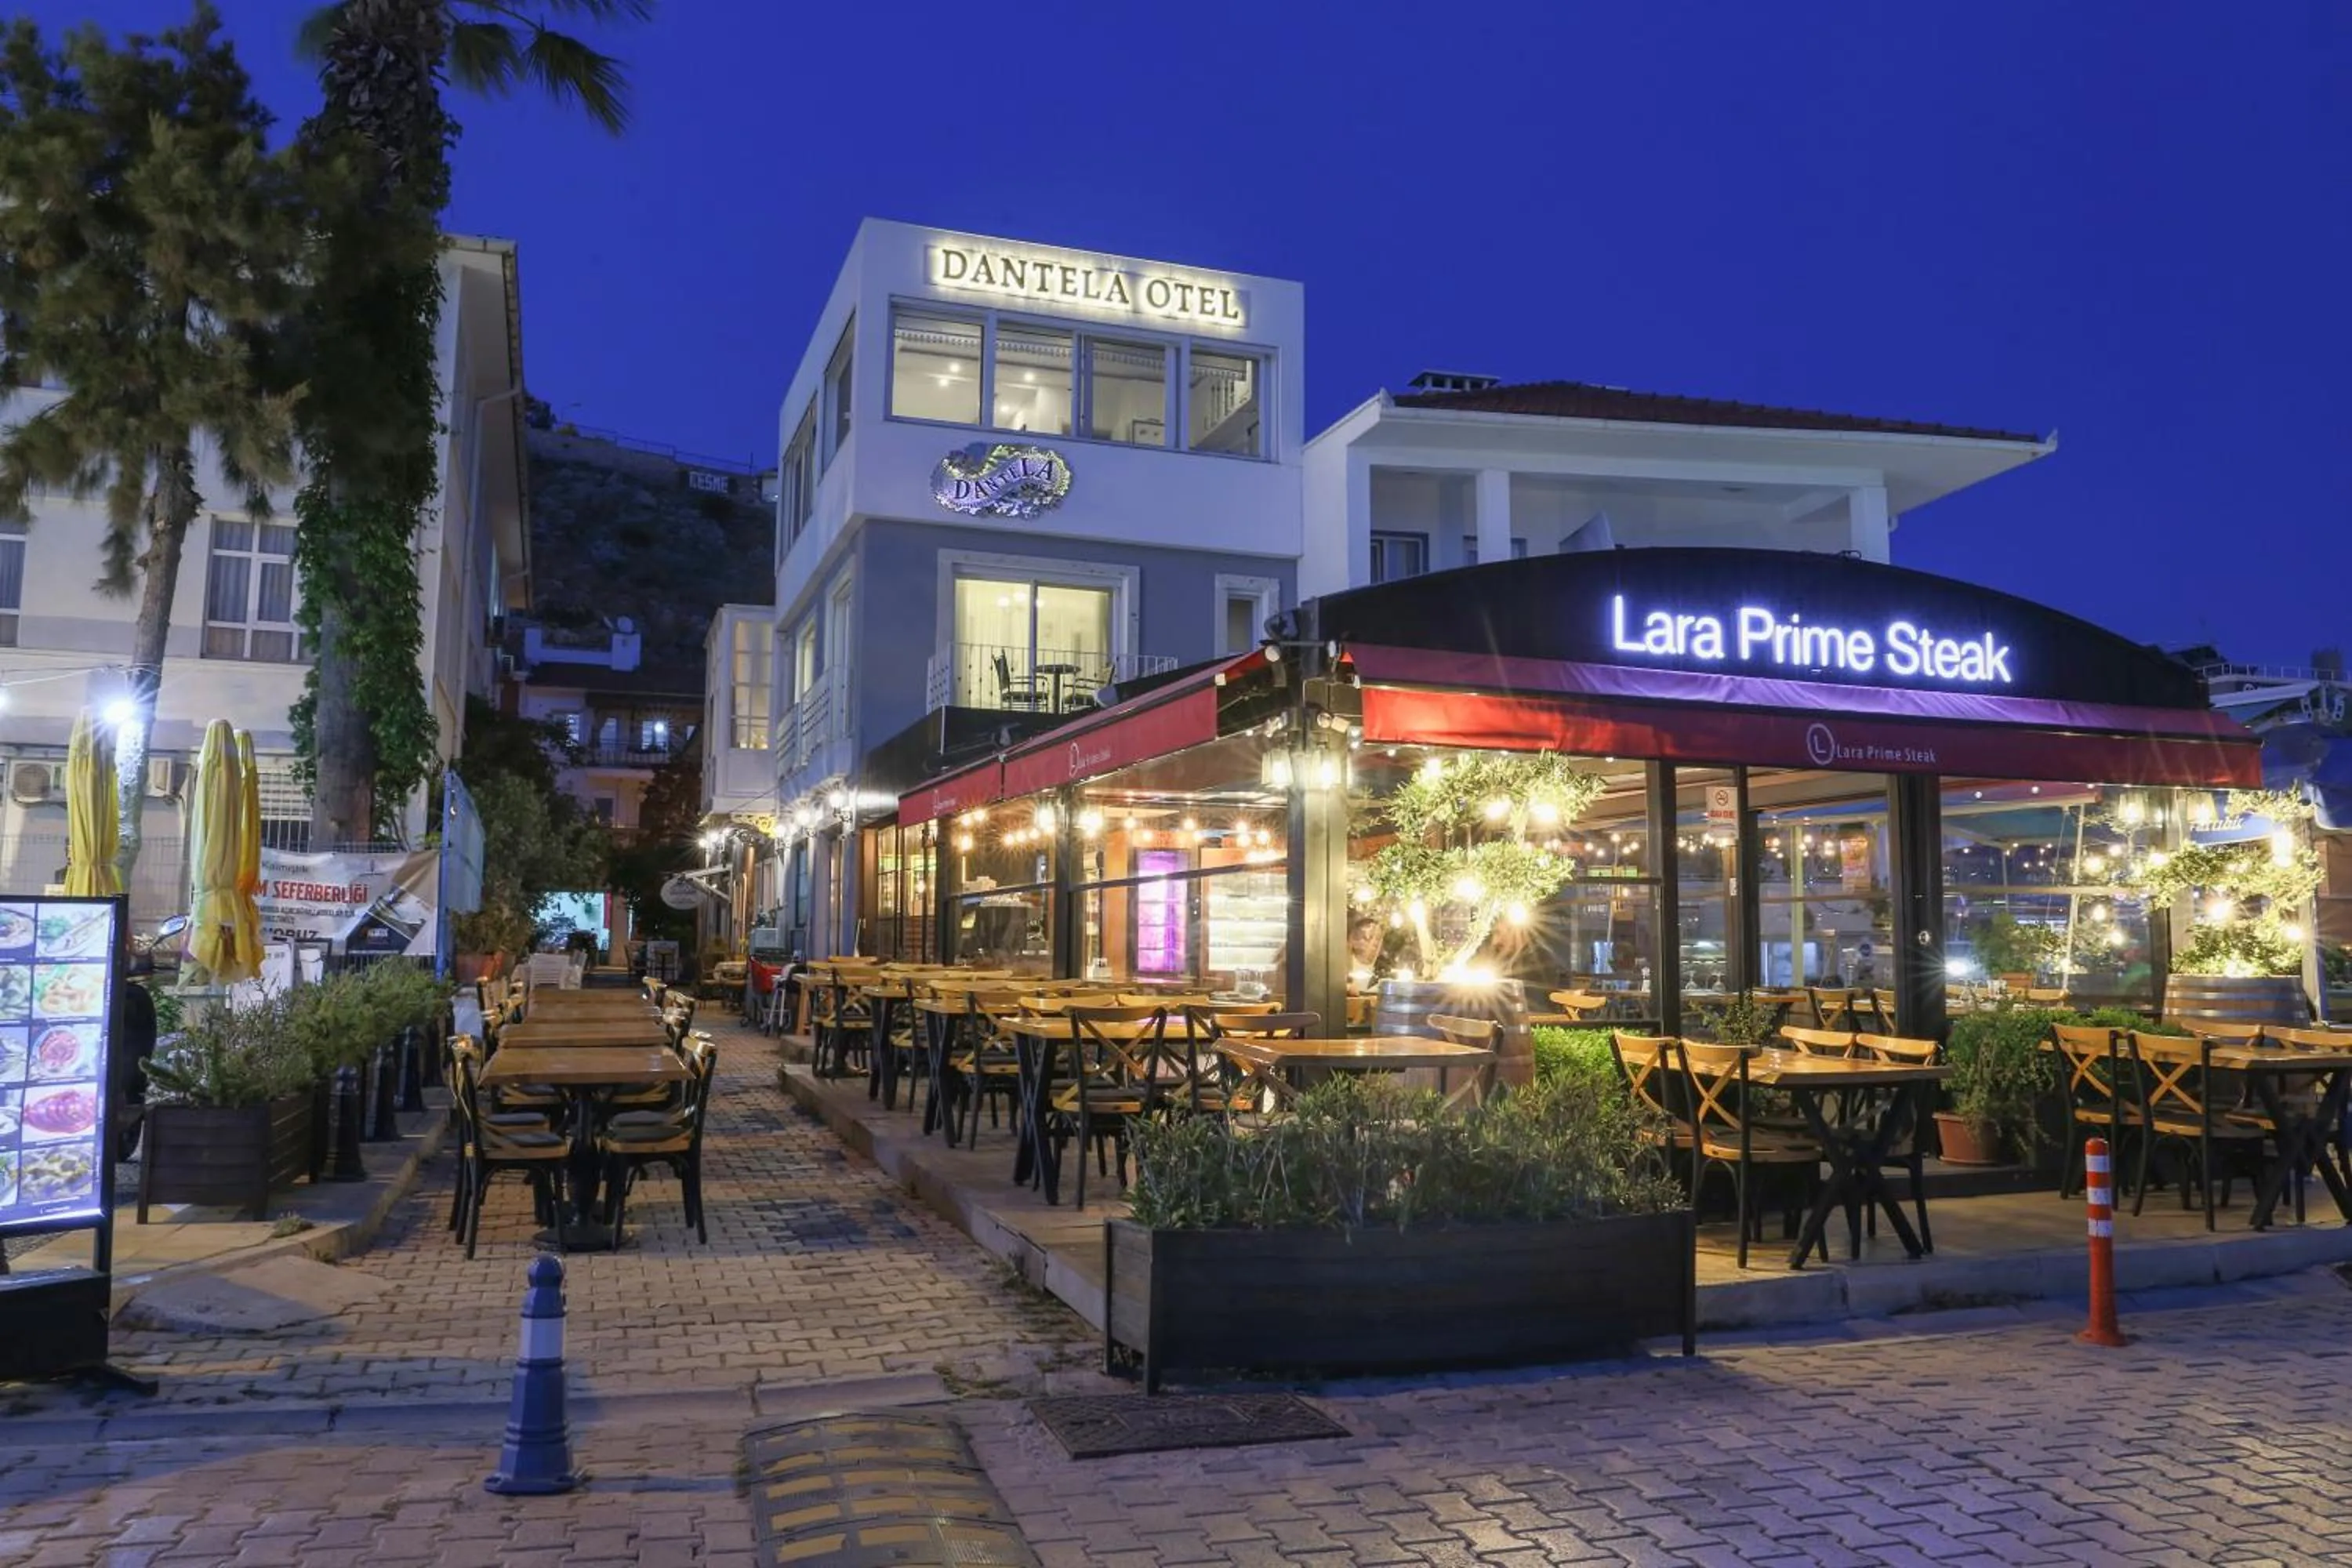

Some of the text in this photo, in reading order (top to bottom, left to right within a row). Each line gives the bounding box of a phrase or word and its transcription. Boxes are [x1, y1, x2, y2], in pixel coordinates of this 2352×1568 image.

[942, 249, 1239, 319] DANTELA OTEL
[953, 457, 1054, 499] DANTELA
[1613, 594, 2012, 683] Lara Prime Steak
[1837, 744, 1936, 764] Lara Prime Steak
[272, 880, 368, 904] SEFERBERLİĞİ
